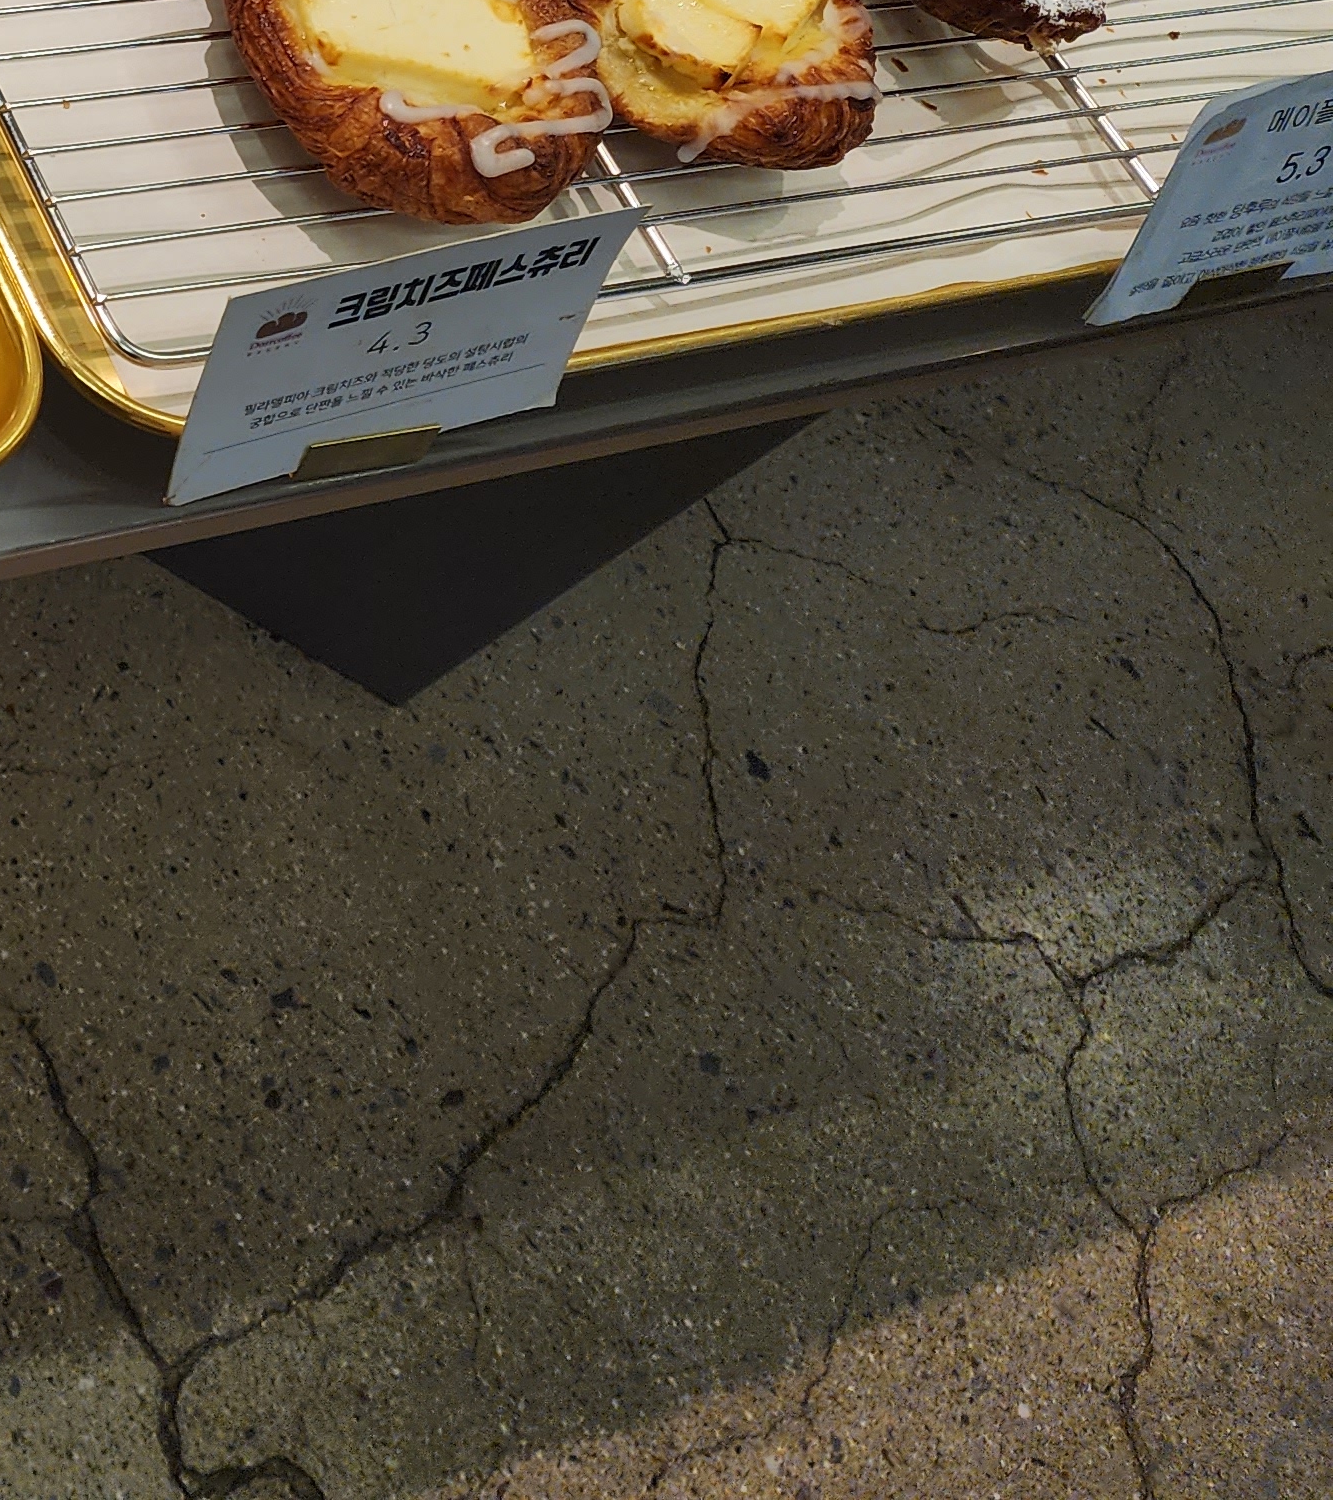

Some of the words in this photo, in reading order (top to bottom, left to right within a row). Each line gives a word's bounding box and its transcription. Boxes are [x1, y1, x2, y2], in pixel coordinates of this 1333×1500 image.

[1275, 145, 1331, 183] 5.3
[328, 236, 601, 330] 크림치즈페스츄리
[366, 320, 432, 354] 4.3
[244, 389, 310, 416] 필라델피아
[312, 371, 378, 398] 크림치즈와
[382, 360, 420, 379] 적당한
[422, 348, 463, 367] 당도의
[249, 407, 302, 430] 궁합으로
[376, 385, 388, 396] 수
[390, 378, 418, 392] 있는
[421, 366, 460, 383] 바삭한
[462, 350, 514, 372] 페스츄리
